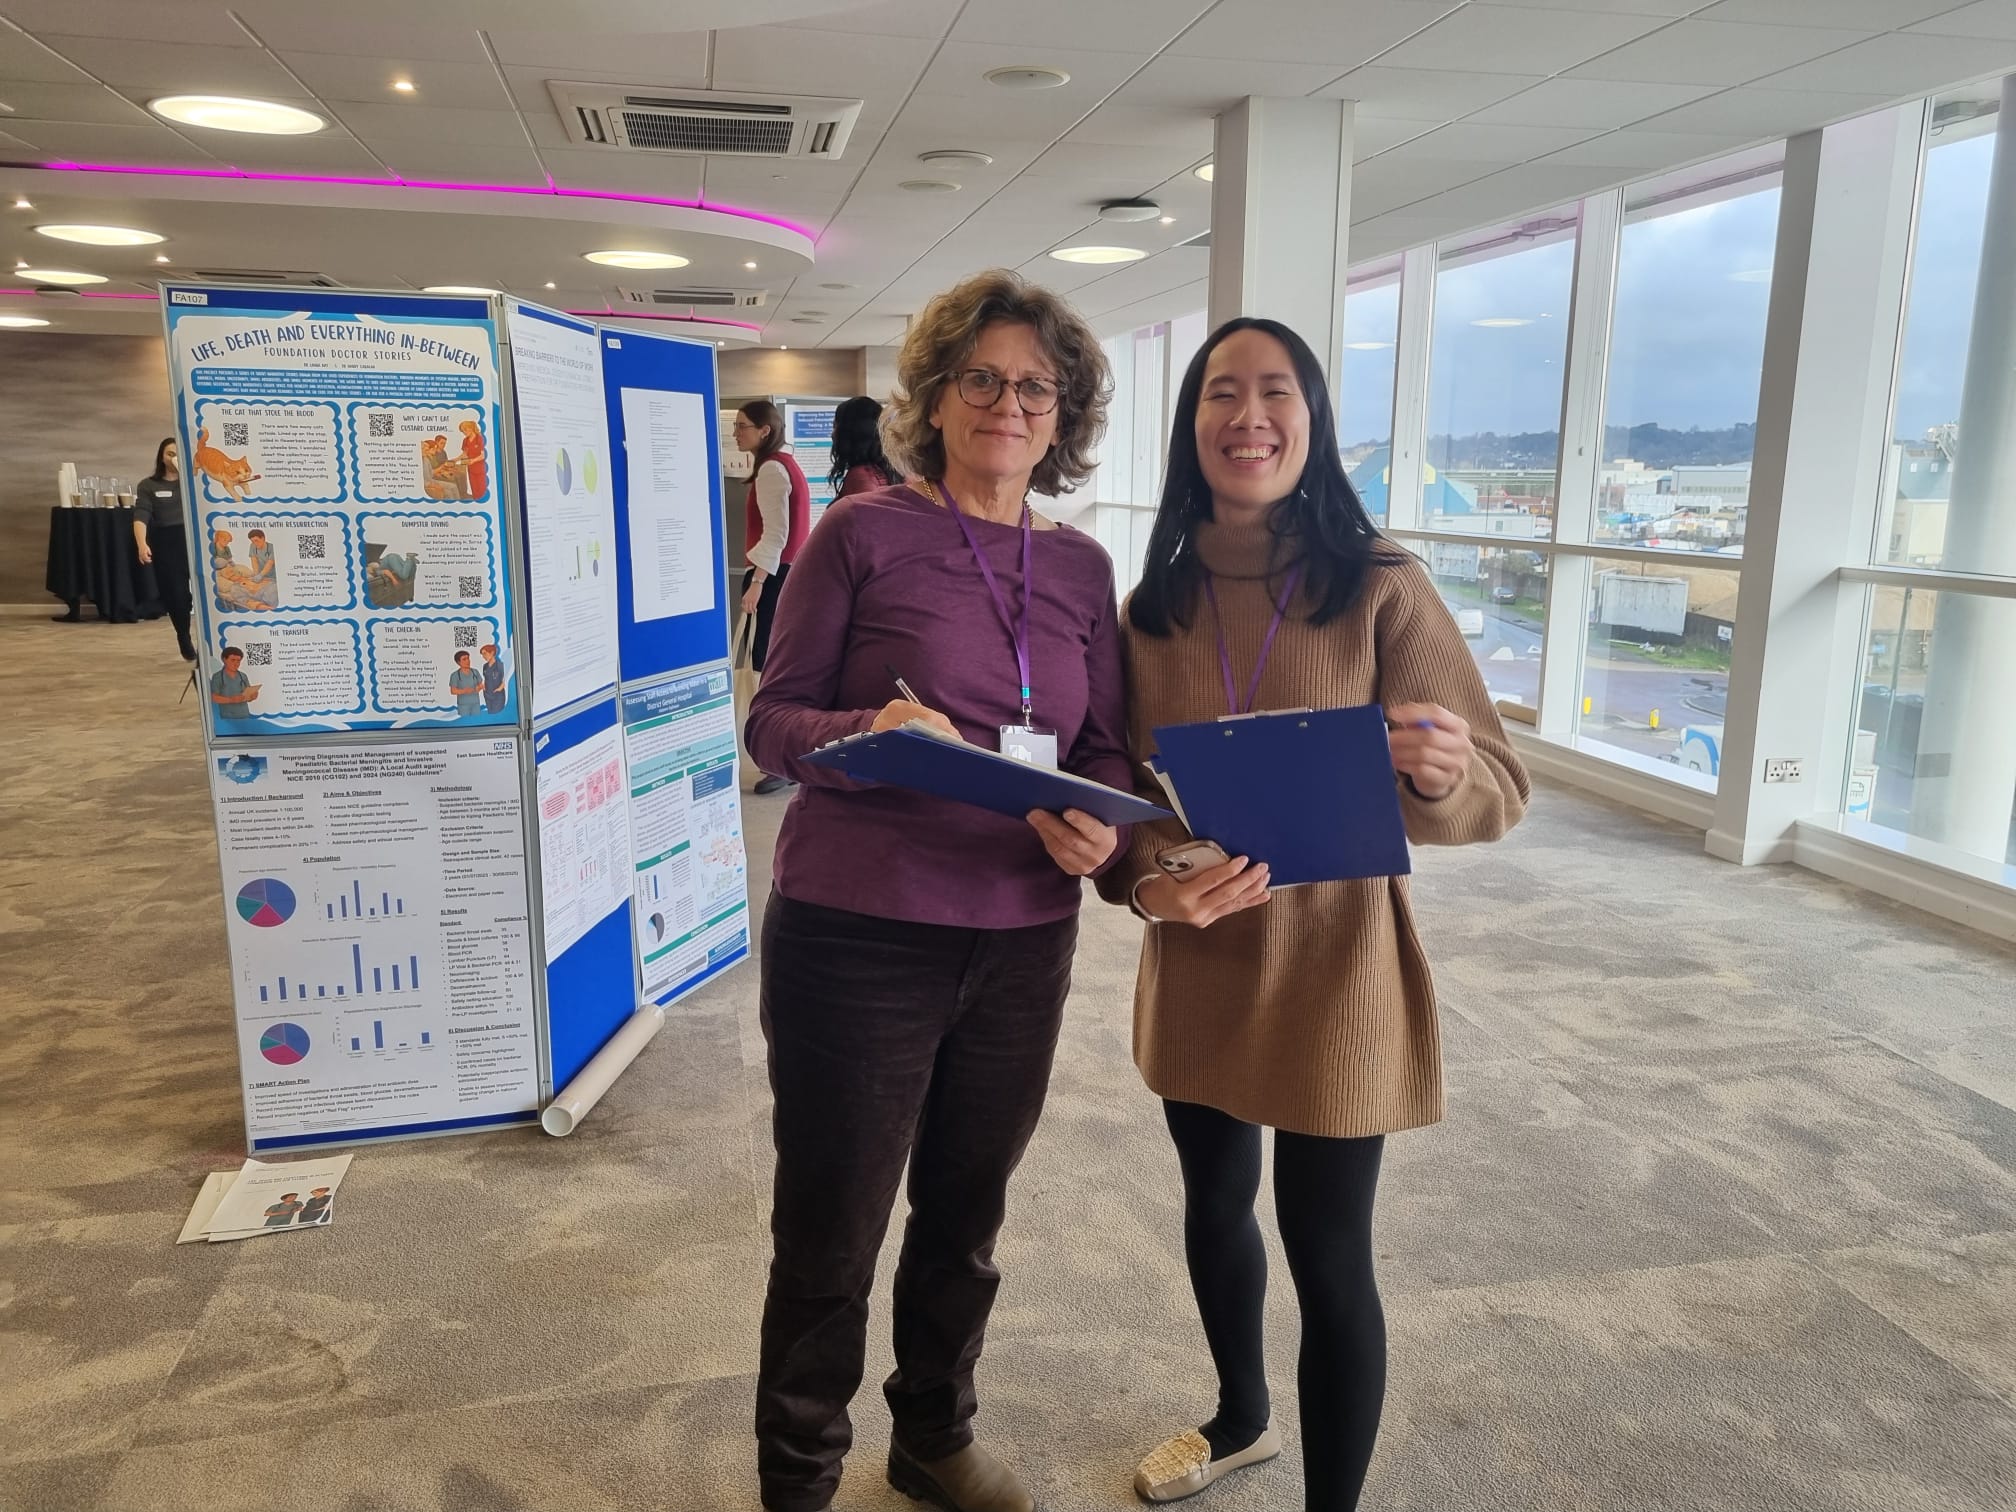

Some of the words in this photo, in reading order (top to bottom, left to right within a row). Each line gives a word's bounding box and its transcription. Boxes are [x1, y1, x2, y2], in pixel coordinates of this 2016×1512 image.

[176, 294, 203, 303] FA107
[191, 341, 224, 362] LIFE,
[225, 329, 271, 351] DEATH
[278, 325, 304, 342] AND
[311, 324, 395, 345] EVERYTHING
[401, 333, 480, 370] IN-BETWEEN
[264, 347, 325, 358] FOUNDATION
[331, 349, 368, 359] DOCTOR
[375, 351, 411, 360] STORIES
